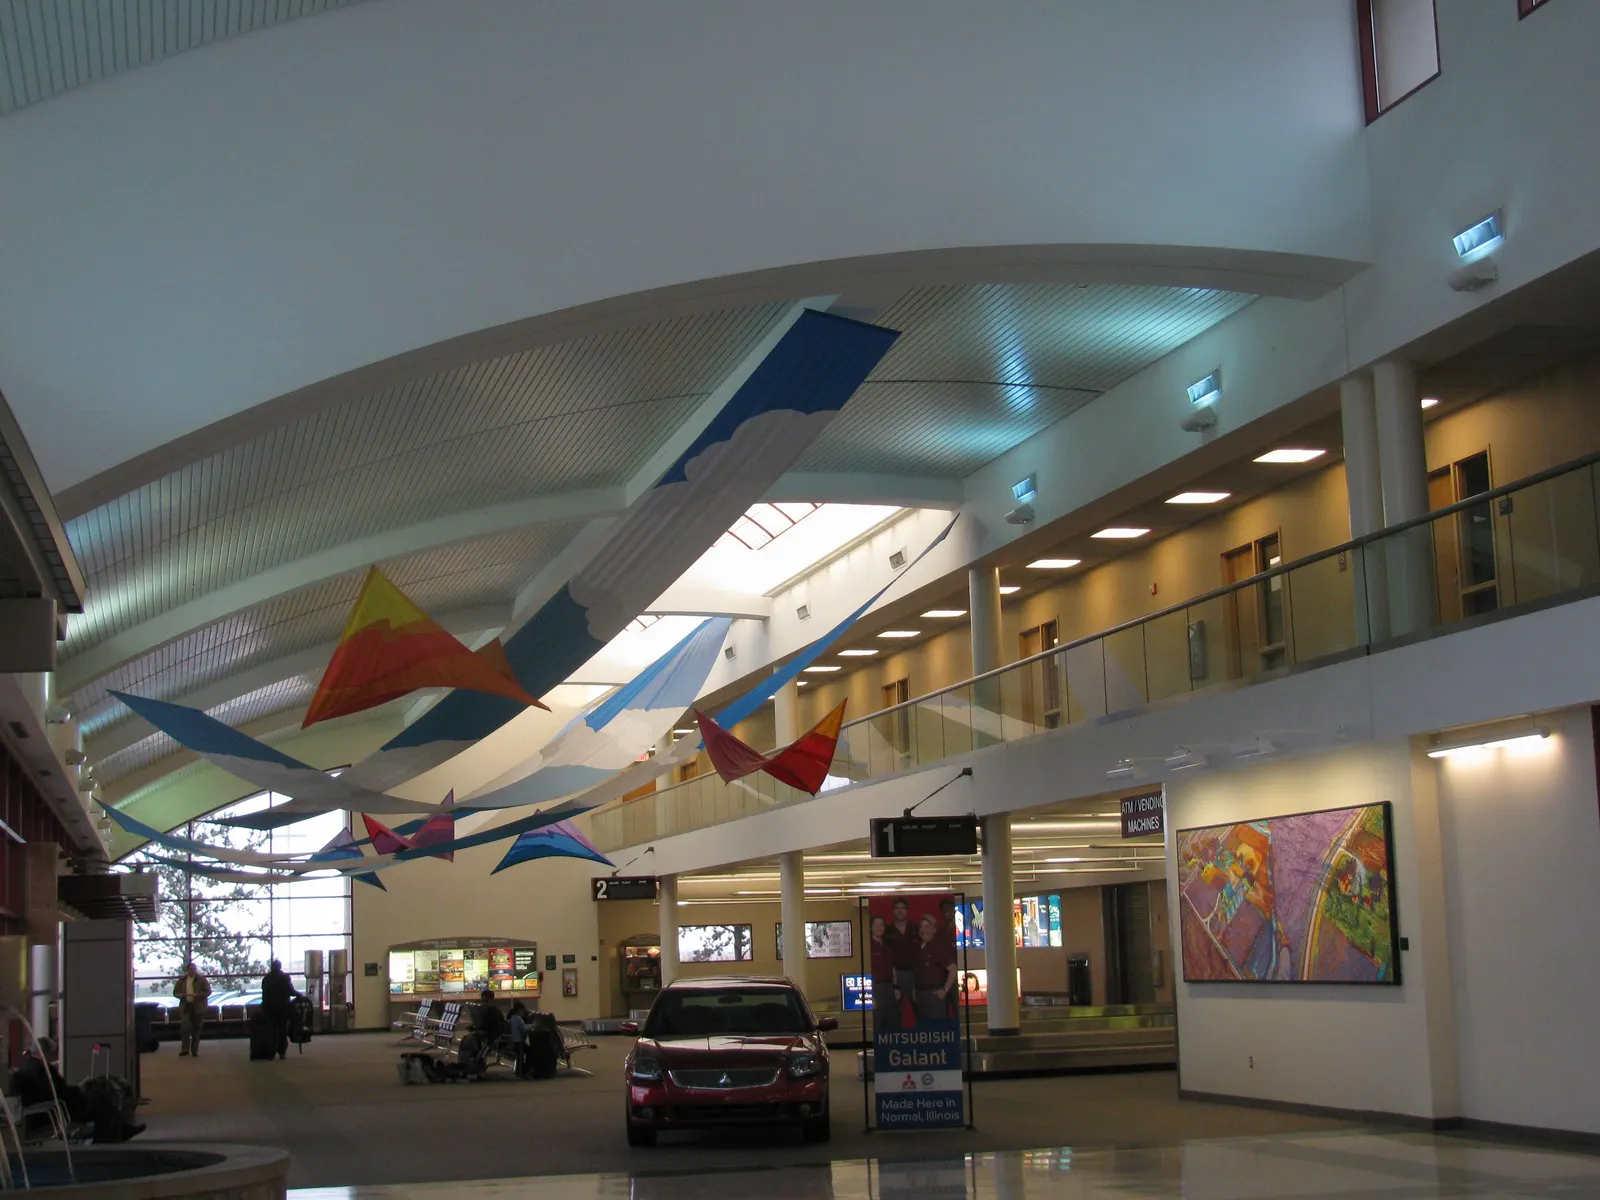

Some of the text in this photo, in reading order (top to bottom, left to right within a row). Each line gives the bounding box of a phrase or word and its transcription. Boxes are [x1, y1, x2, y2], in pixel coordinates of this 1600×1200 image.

[1121, 800, 1133, 814] ATM
[1128, 816, 1160, 833] MACHINES
[883, 823, 895, 853] 1
[596, 880, 608, 899] 2
[878, 1031, 955, 1045] MITSUBISHI
[889, 1048, 947, 1067] Galant
[882, 1097, 956, 1110] Made Here in
[881, 1109, 960, 1123] Normal, Illinois
